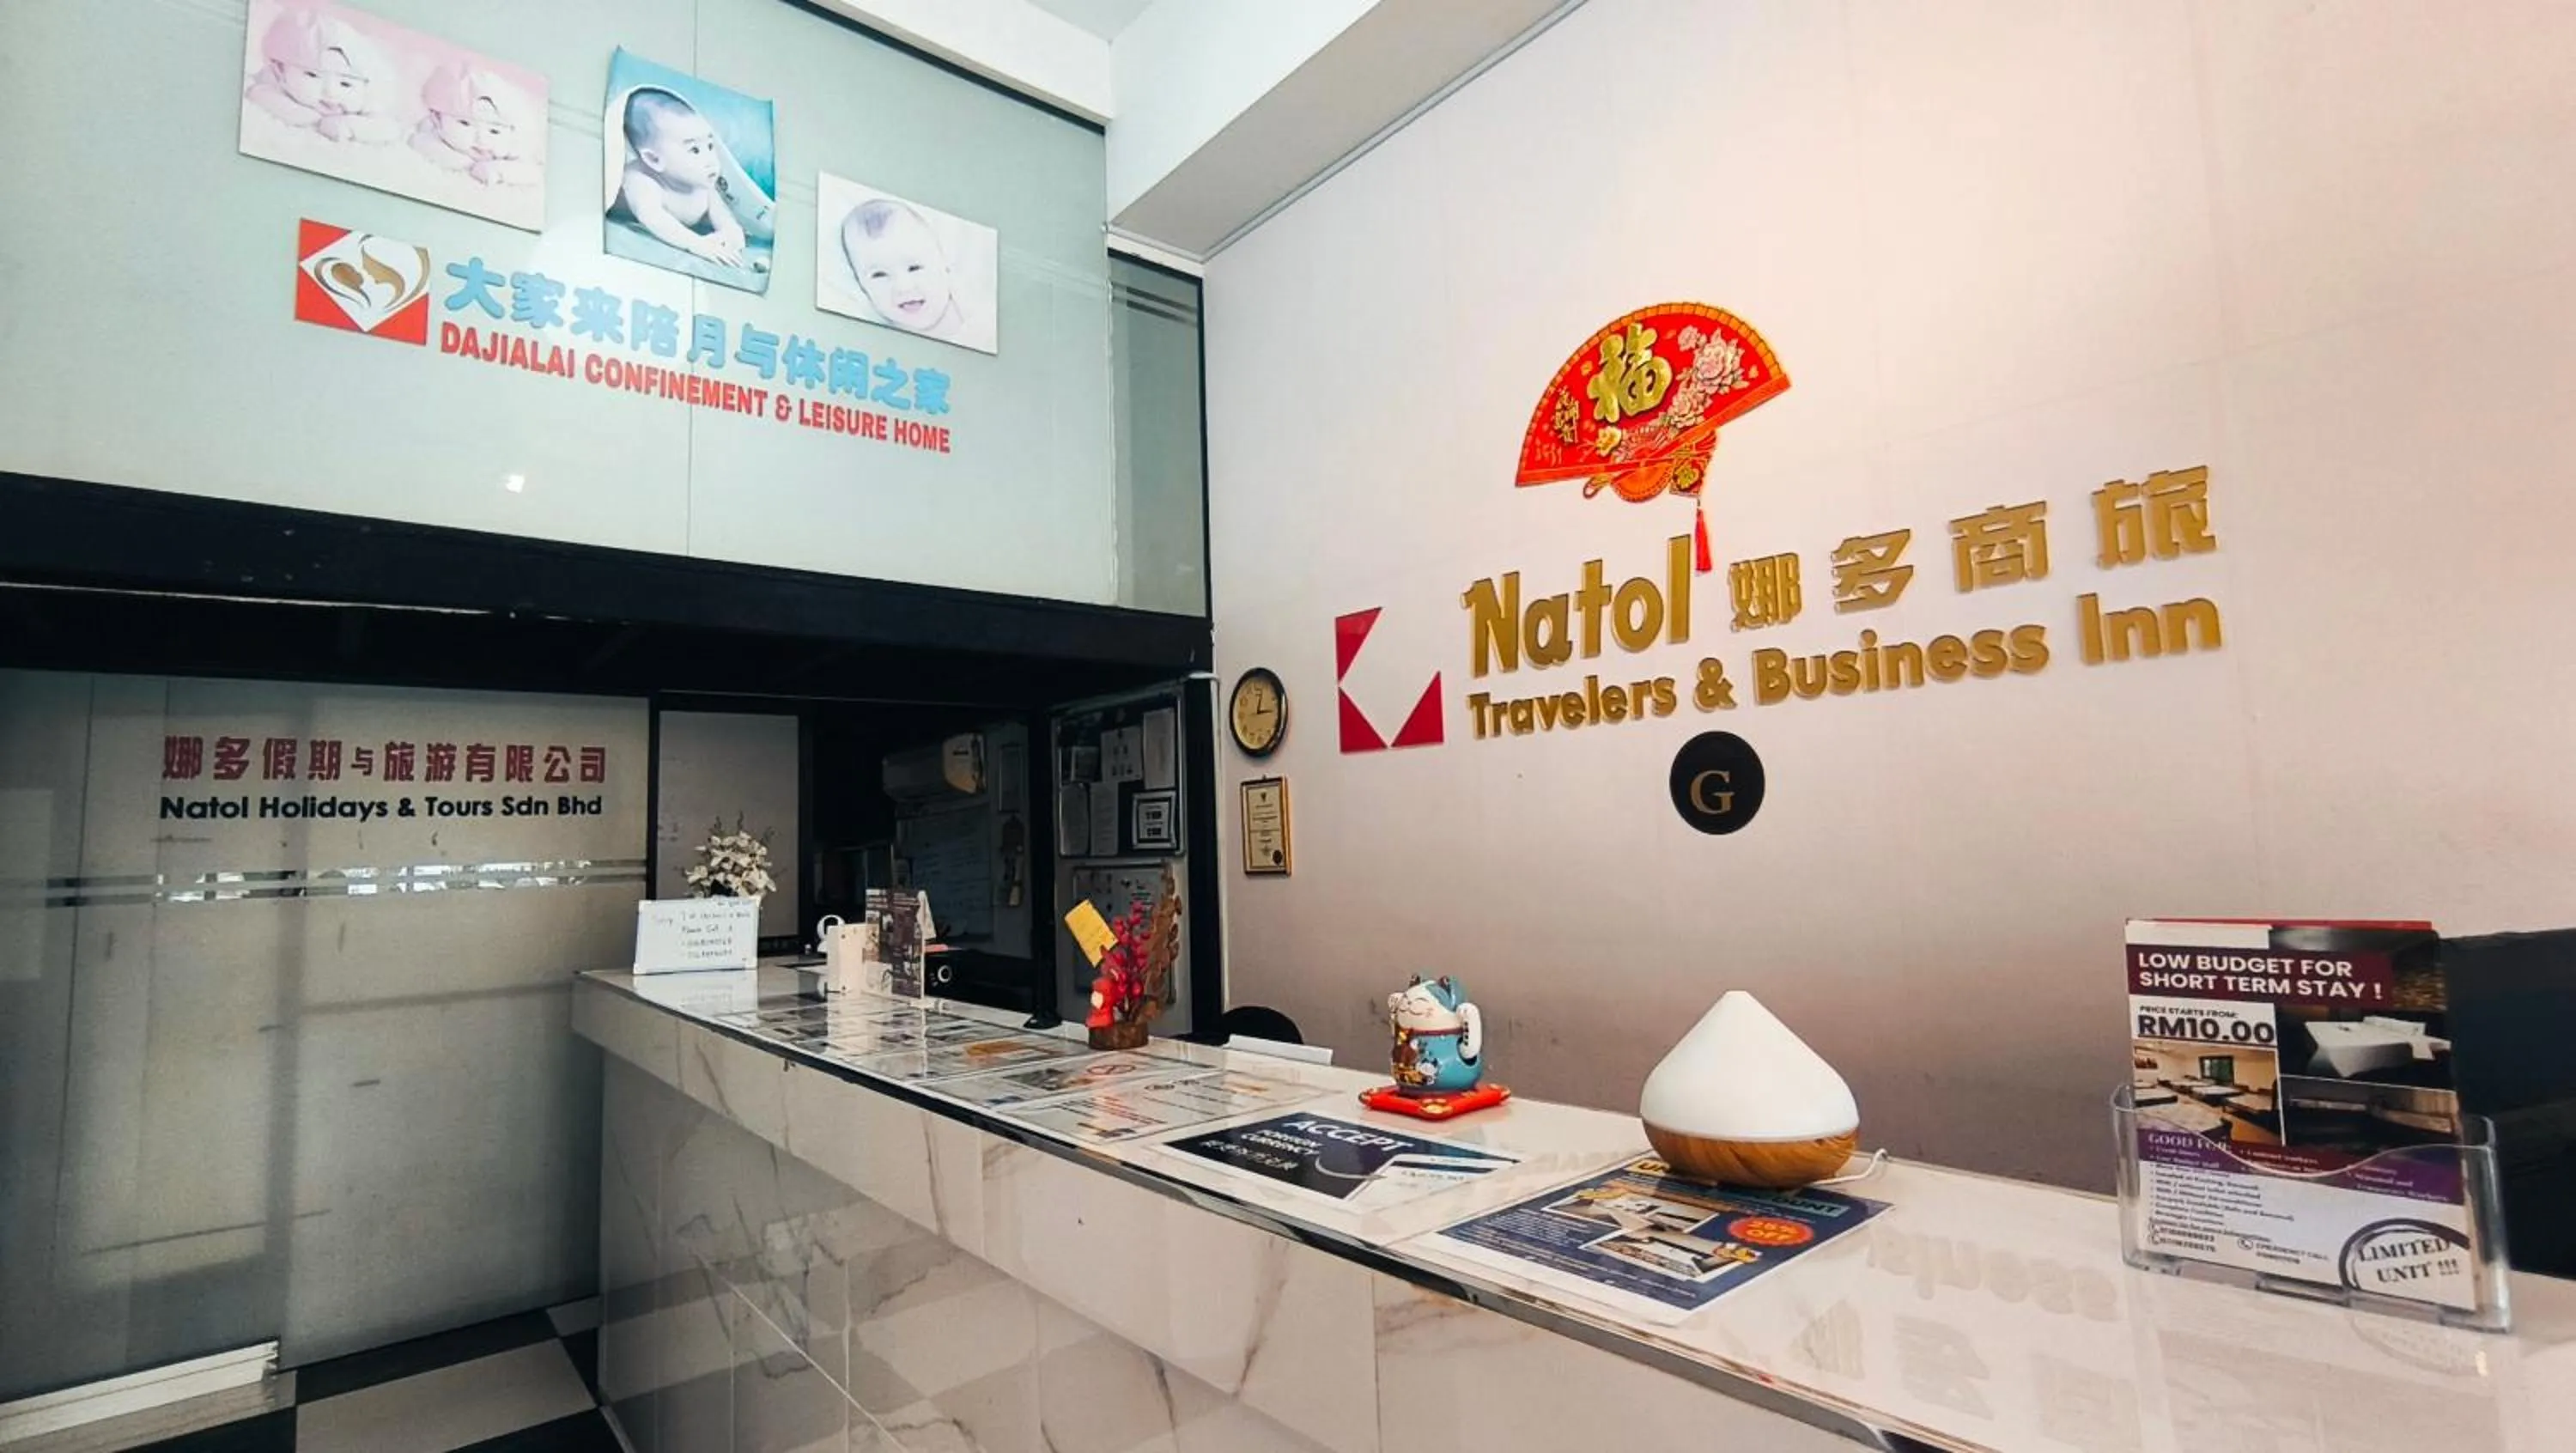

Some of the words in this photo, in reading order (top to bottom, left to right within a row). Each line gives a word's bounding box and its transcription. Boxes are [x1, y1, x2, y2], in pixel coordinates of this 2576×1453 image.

[445, 256, 951, 416] 大家来陪月与休闲之家
[440, 321, 576, 380] DAJIALAI
[585, 353, 769, 418] CONFINEMENT
[775, 395, 793, 422] &
[798, 399, 887, 441] LEISURE
[894, 418, 951, 454] HOME
[1587, 323, 1673, 423] 福
[1728, 465, 2217, 632] 娜多商旅
[1461, 534, 1692, 678] Natol
[1467, 672, 1677, 739] Travelers
[1694, 656, 1736, 712] &
[1753, 627, 2050, 706] Business
[2076, 591, 2223, 667] Inn
[162, 735, 606, 783] 娜多假期与旅游有限公司
[1689, 769, 1735, 815] G
[161, 795, 248, 820] Natol
[259, 795, 388, 824] Holidays
[398, 796, 416, 818] &
[425, 795, 492, 818] Tours
[501, 794, 549, 817] Sdn
[557, 794, 602, 817] Bhd
[2138, 952, 2190, 970] LOW
[2196, 954, 2294, 975] BUDGET
[2300, 959, 2353, 977] FOR
[2139, 971, 2218, 990] SHORT
[2224, 975, 2291, 994] TERM
[2297, 979, 2370, 1000] STAY
[2139, 1005, 2166, 1014] PRICE
[2138, 1013, 2275, 1044] RM10.00
[1282, 1120, 1414, 1152] ACCEPT
[2148, 1133, 2194, 1147] GOOD
[1745, 1228, 1792, 1242] OFF
[2358, 1237, 2451, 1263] LIMITED
[2376, 1261, 2433, 1284] UNIT
